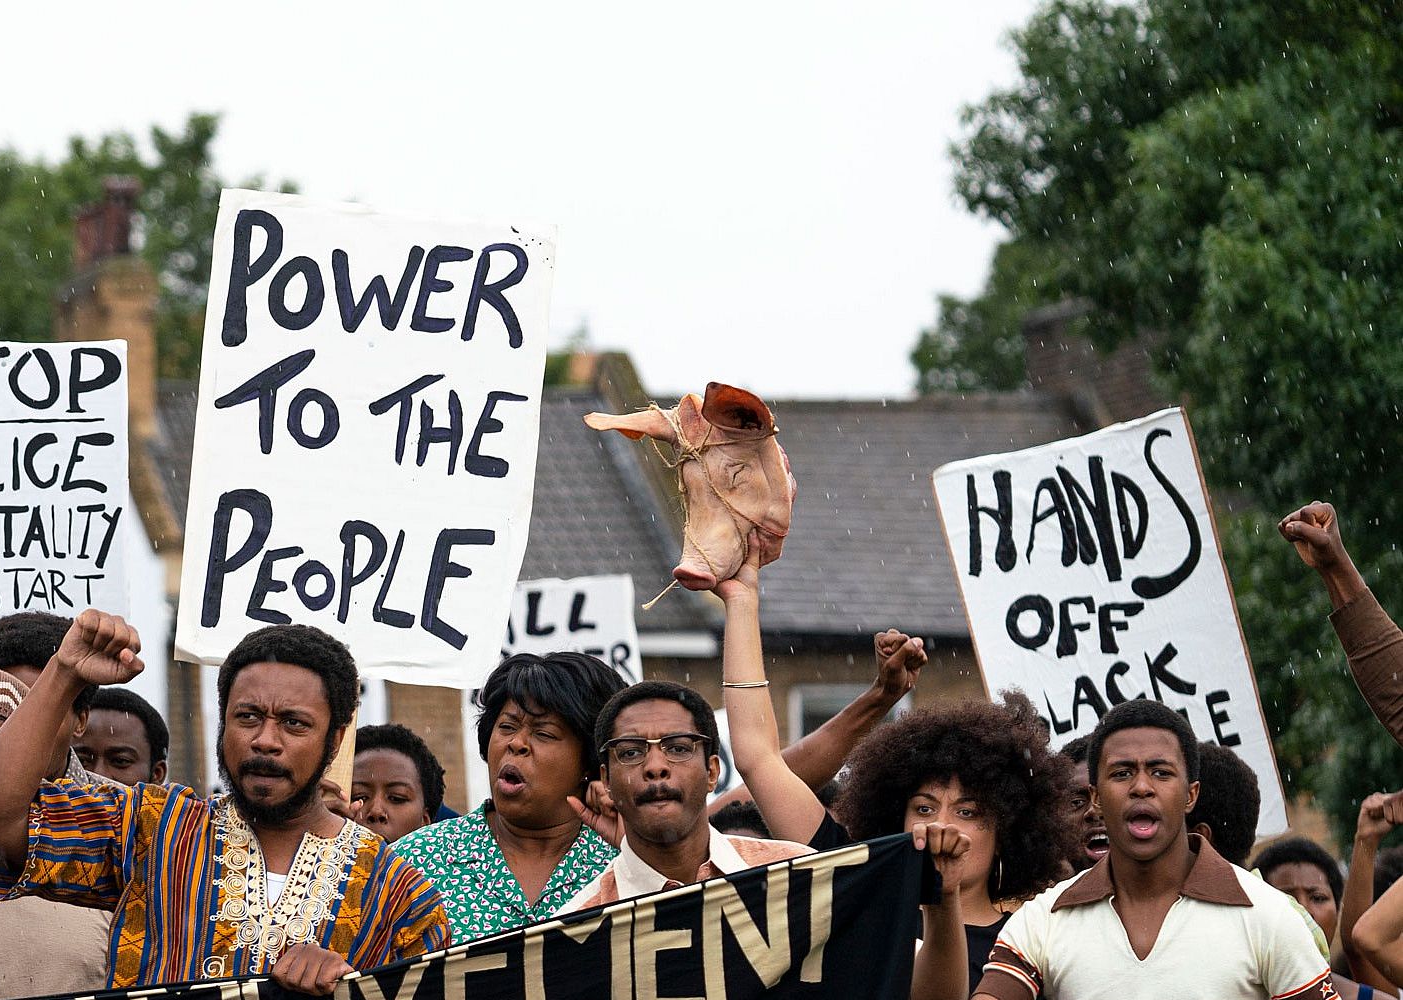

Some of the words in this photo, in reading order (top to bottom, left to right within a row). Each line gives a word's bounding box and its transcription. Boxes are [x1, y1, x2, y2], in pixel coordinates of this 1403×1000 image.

[220, 209, 530, 349] POWER
[214, 349, 341, 454] TO
[368, 373, 529, 479] THE
[200, 488, 496, 651] PEOPLE
[967, 429, 1202, 602] HANDS
[506, 590, 597, 645] LL
[1005, 593, 1146, 659] OFF
[1040, 643, 1197, 736] LACK
